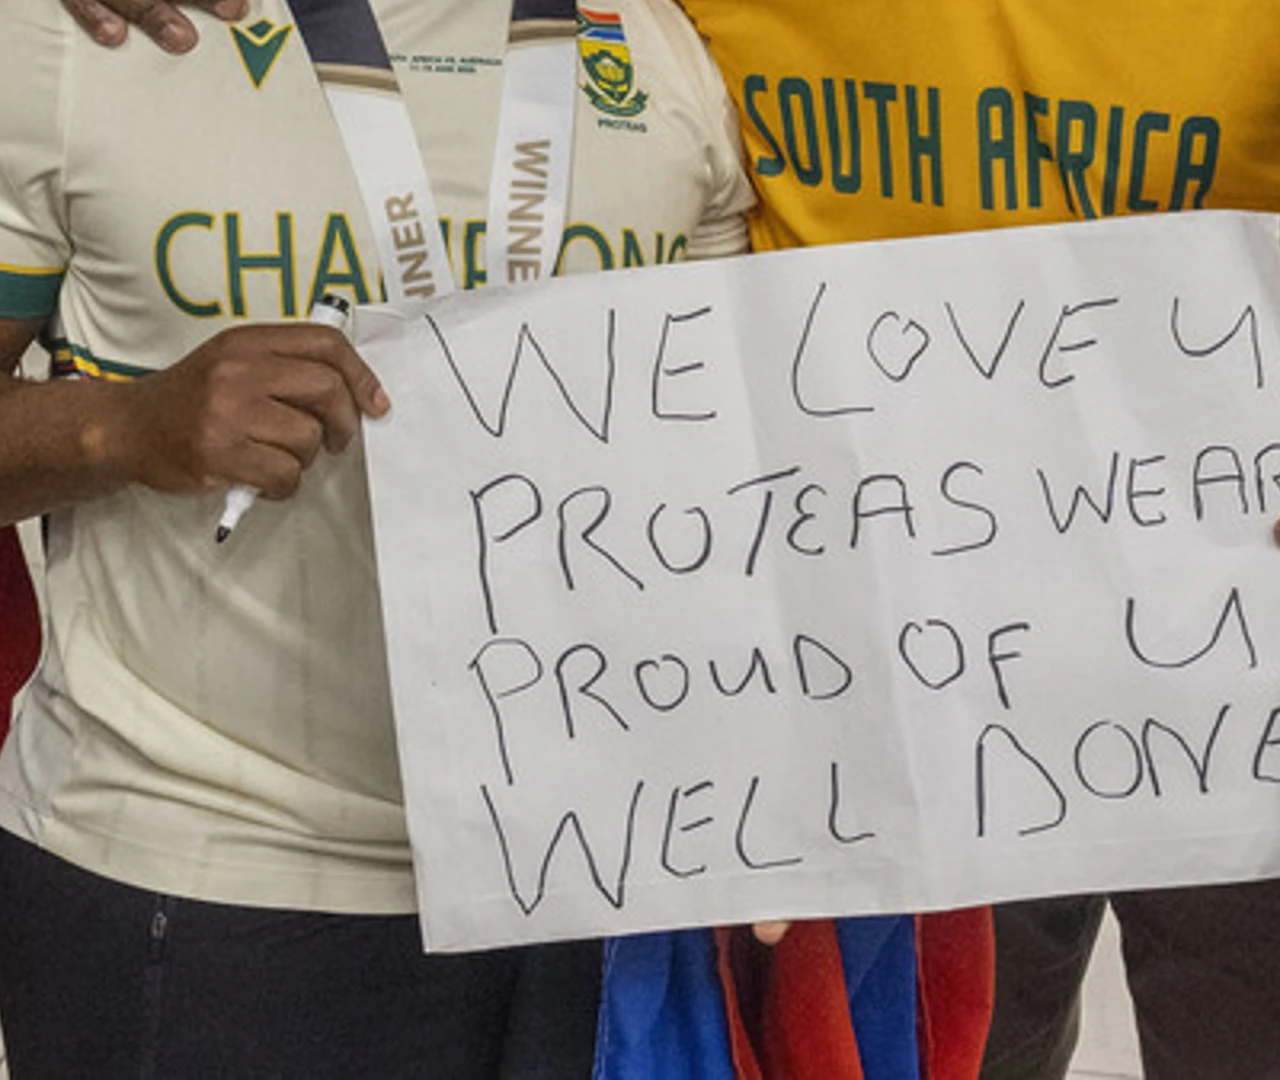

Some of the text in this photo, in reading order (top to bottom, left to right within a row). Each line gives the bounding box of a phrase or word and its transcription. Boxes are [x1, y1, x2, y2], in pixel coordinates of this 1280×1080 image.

[506, 139, 551, 284] WINNE
[743, 74, 1220, 219] SOUTH AFRICA
[424, 306, 717, 444] WE
[791, 282, 1118, 418] LOVE
[469, 461, 997, 634] PROTEAS
[1036, 451, 1167, 535] WE
[468, 635, 853, 785] PROUD
[898, 619, 1030, 709] OF
[480, 761, 876, 916] WELL
